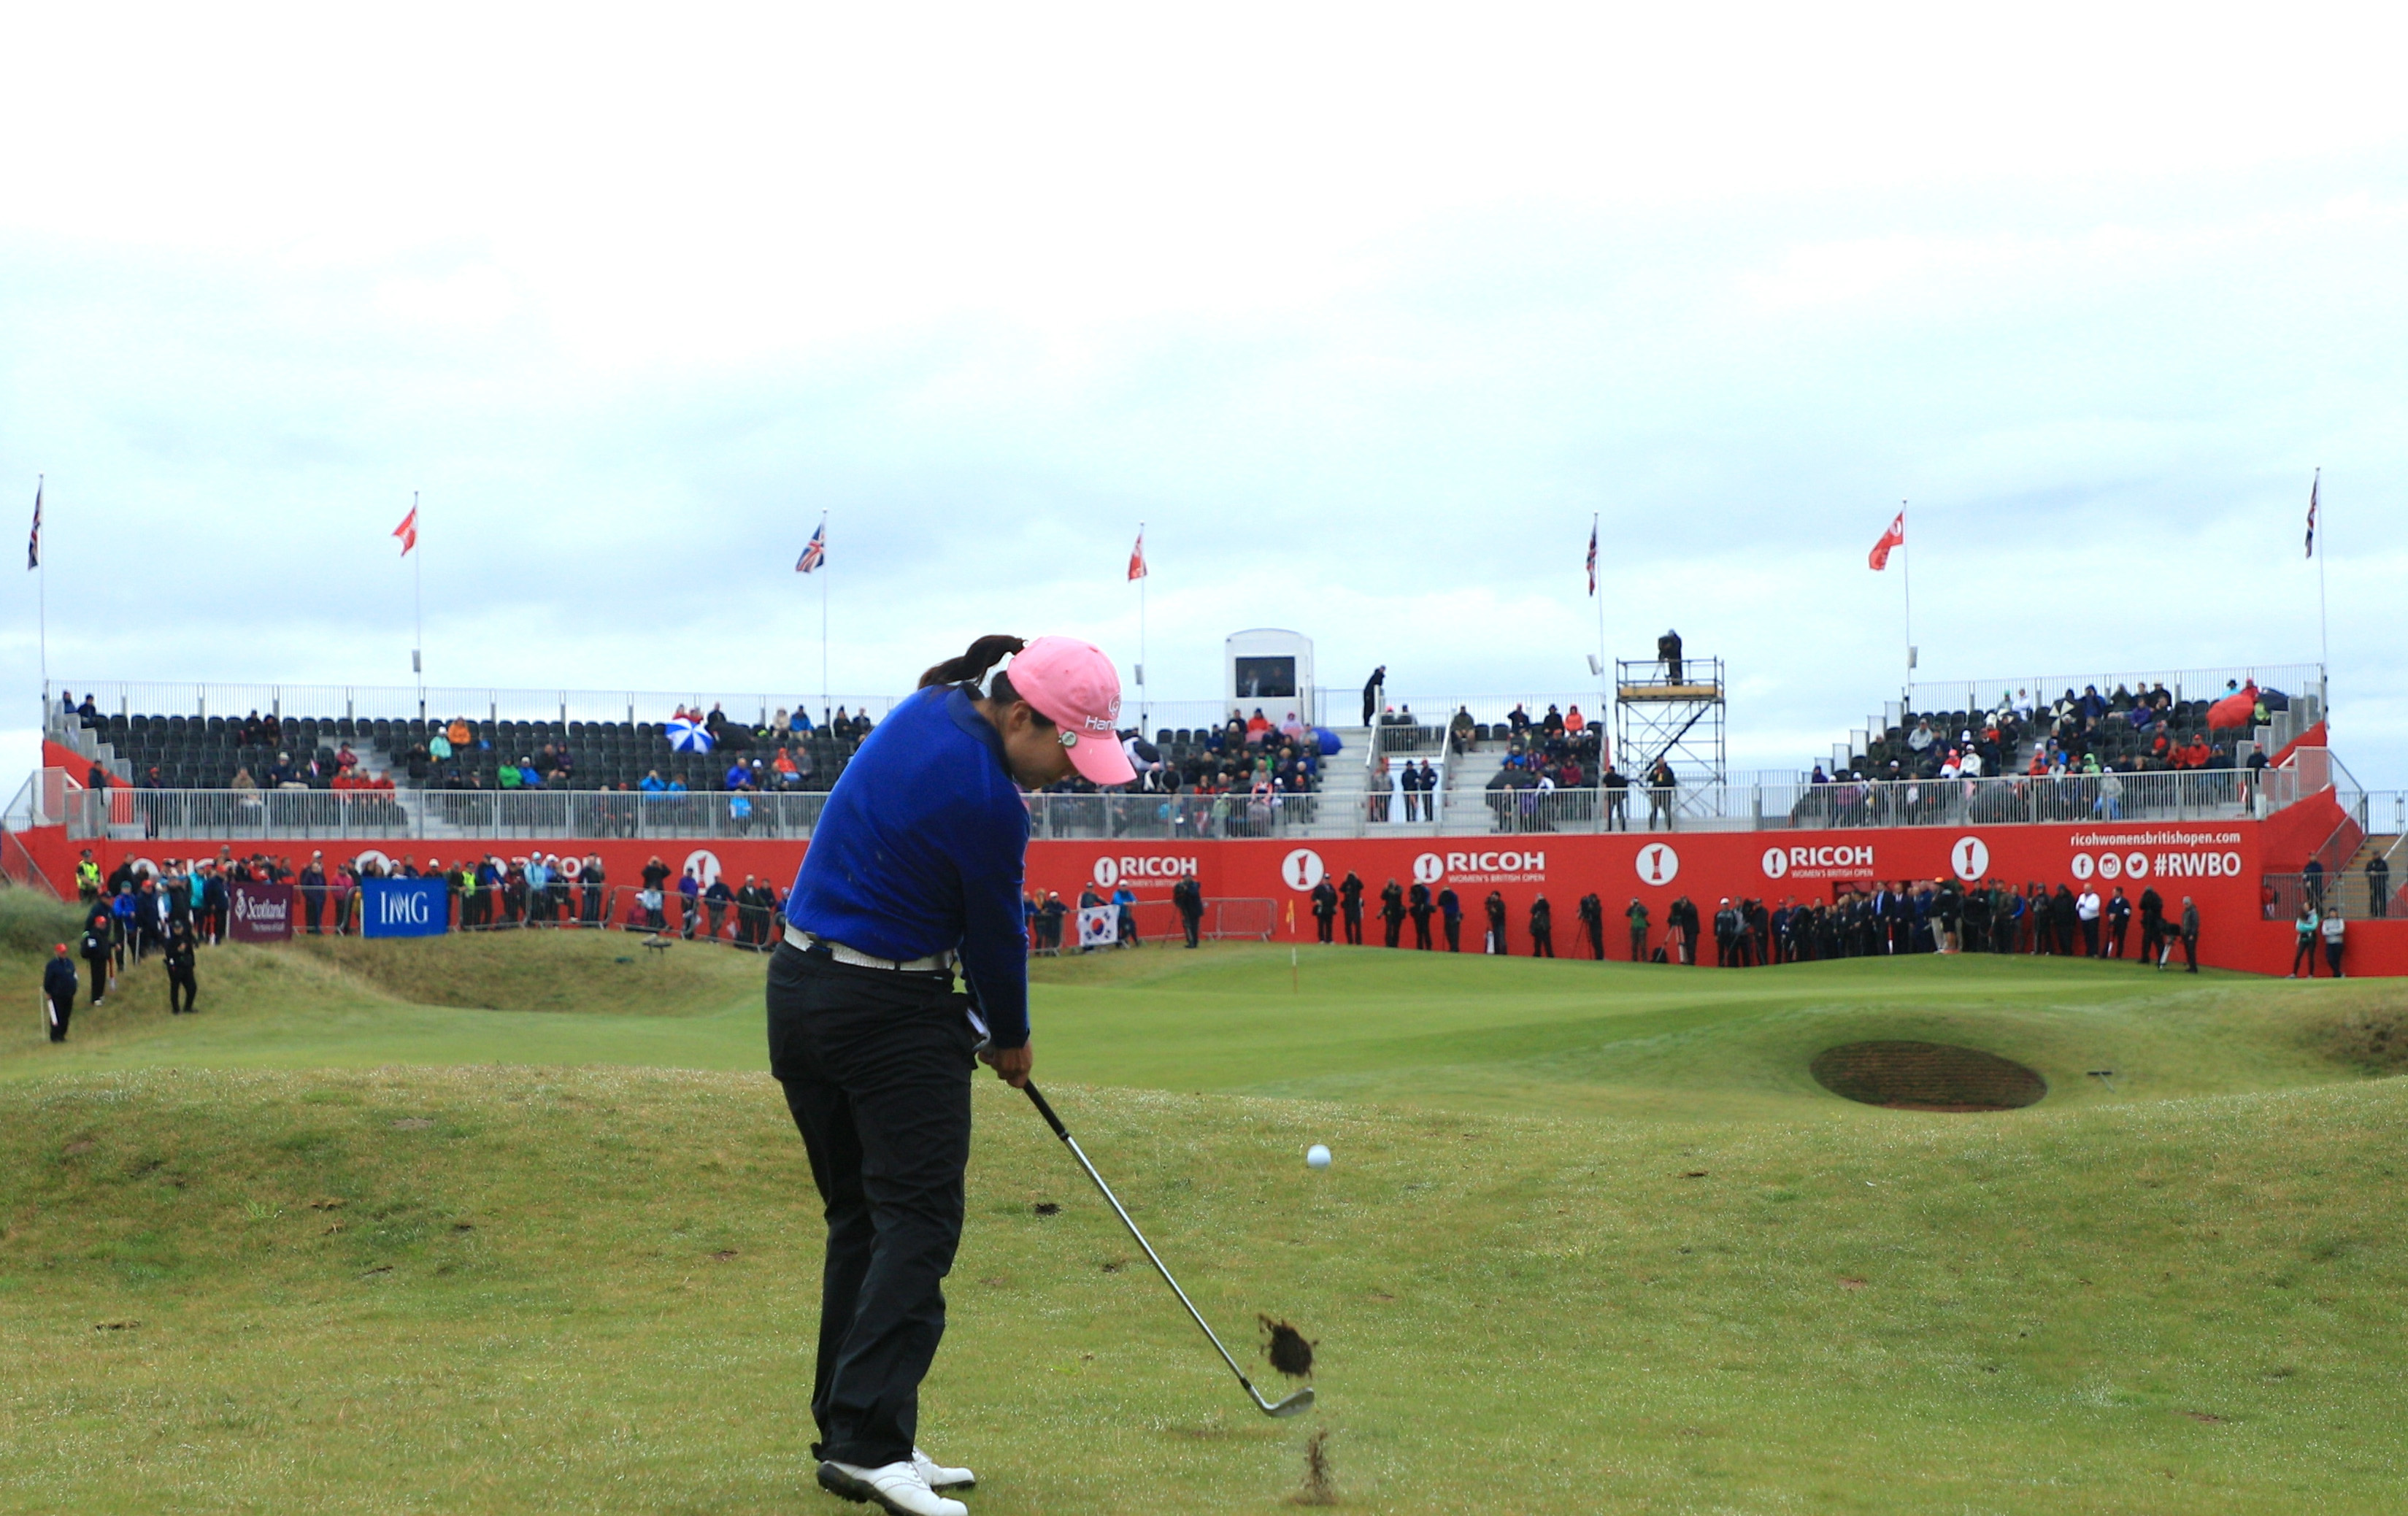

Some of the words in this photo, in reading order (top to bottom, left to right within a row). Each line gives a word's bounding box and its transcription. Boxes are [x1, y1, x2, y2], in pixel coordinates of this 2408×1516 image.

[2070, 830, 2241, 847] ricohwomensbritishopen.com
[1447, 851, 1545, 871] RICOH
[1790, 845, 1873, 866] RICOH
[2154, 851, 2242, 877] #RWBO
[1120, 856, 1198, 877] RICOH
[1854, 868, 1874, 877] OPEN
[1449, 874, 1489, 883] WOMEN'S
[1490, 874, 1520, 882] BRITISH
[1521, 873, 1545, 882] OPEN
[247, 896, 287, 920] Scotland
[380, 890, 428, 925] IMG
